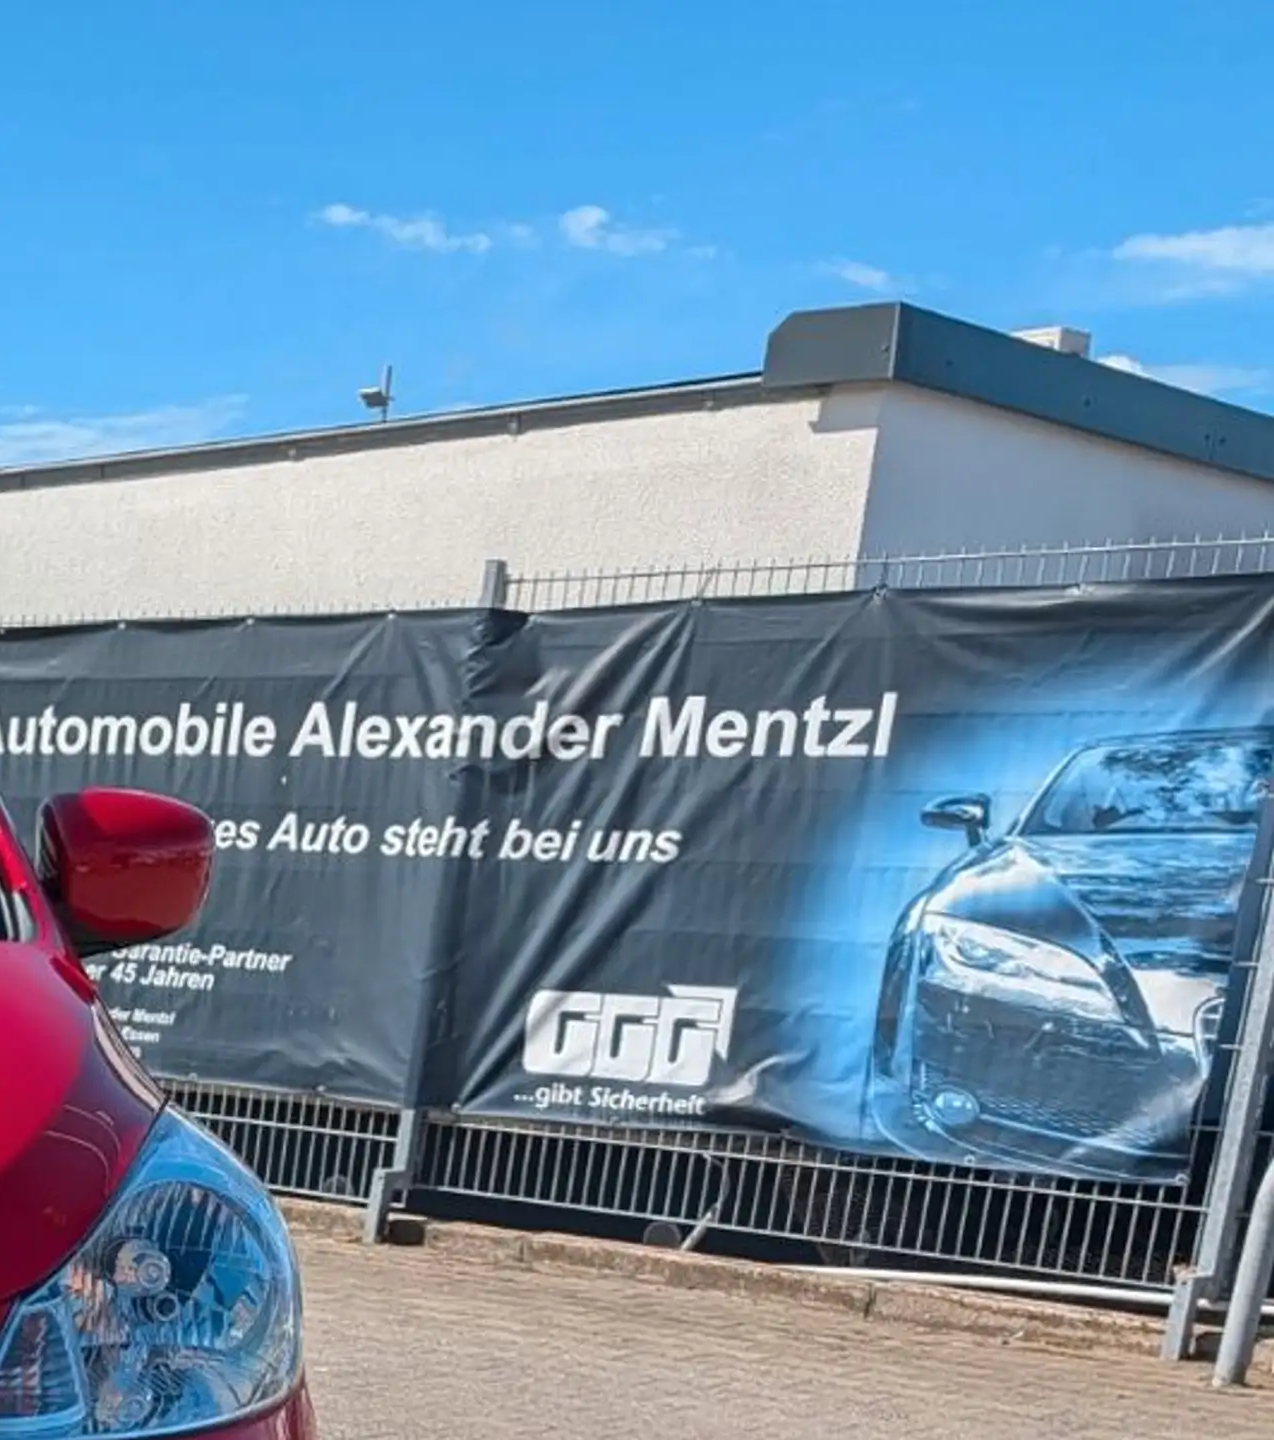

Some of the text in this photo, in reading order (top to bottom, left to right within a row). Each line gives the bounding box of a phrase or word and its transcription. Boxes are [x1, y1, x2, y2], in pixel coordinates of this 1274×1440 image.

[288, 701, 623, 760] Alexander
[638, 692, 899, 758] Mentzl
[211, 812, 682, 864] es Auto steht bei uns
[110, 962, 136, 984] 45
[139, 964, 215, 991] Jahren
[522, 988, 725, 1087] GGG
[588, 1086, 706, 1116] Sicherheit
